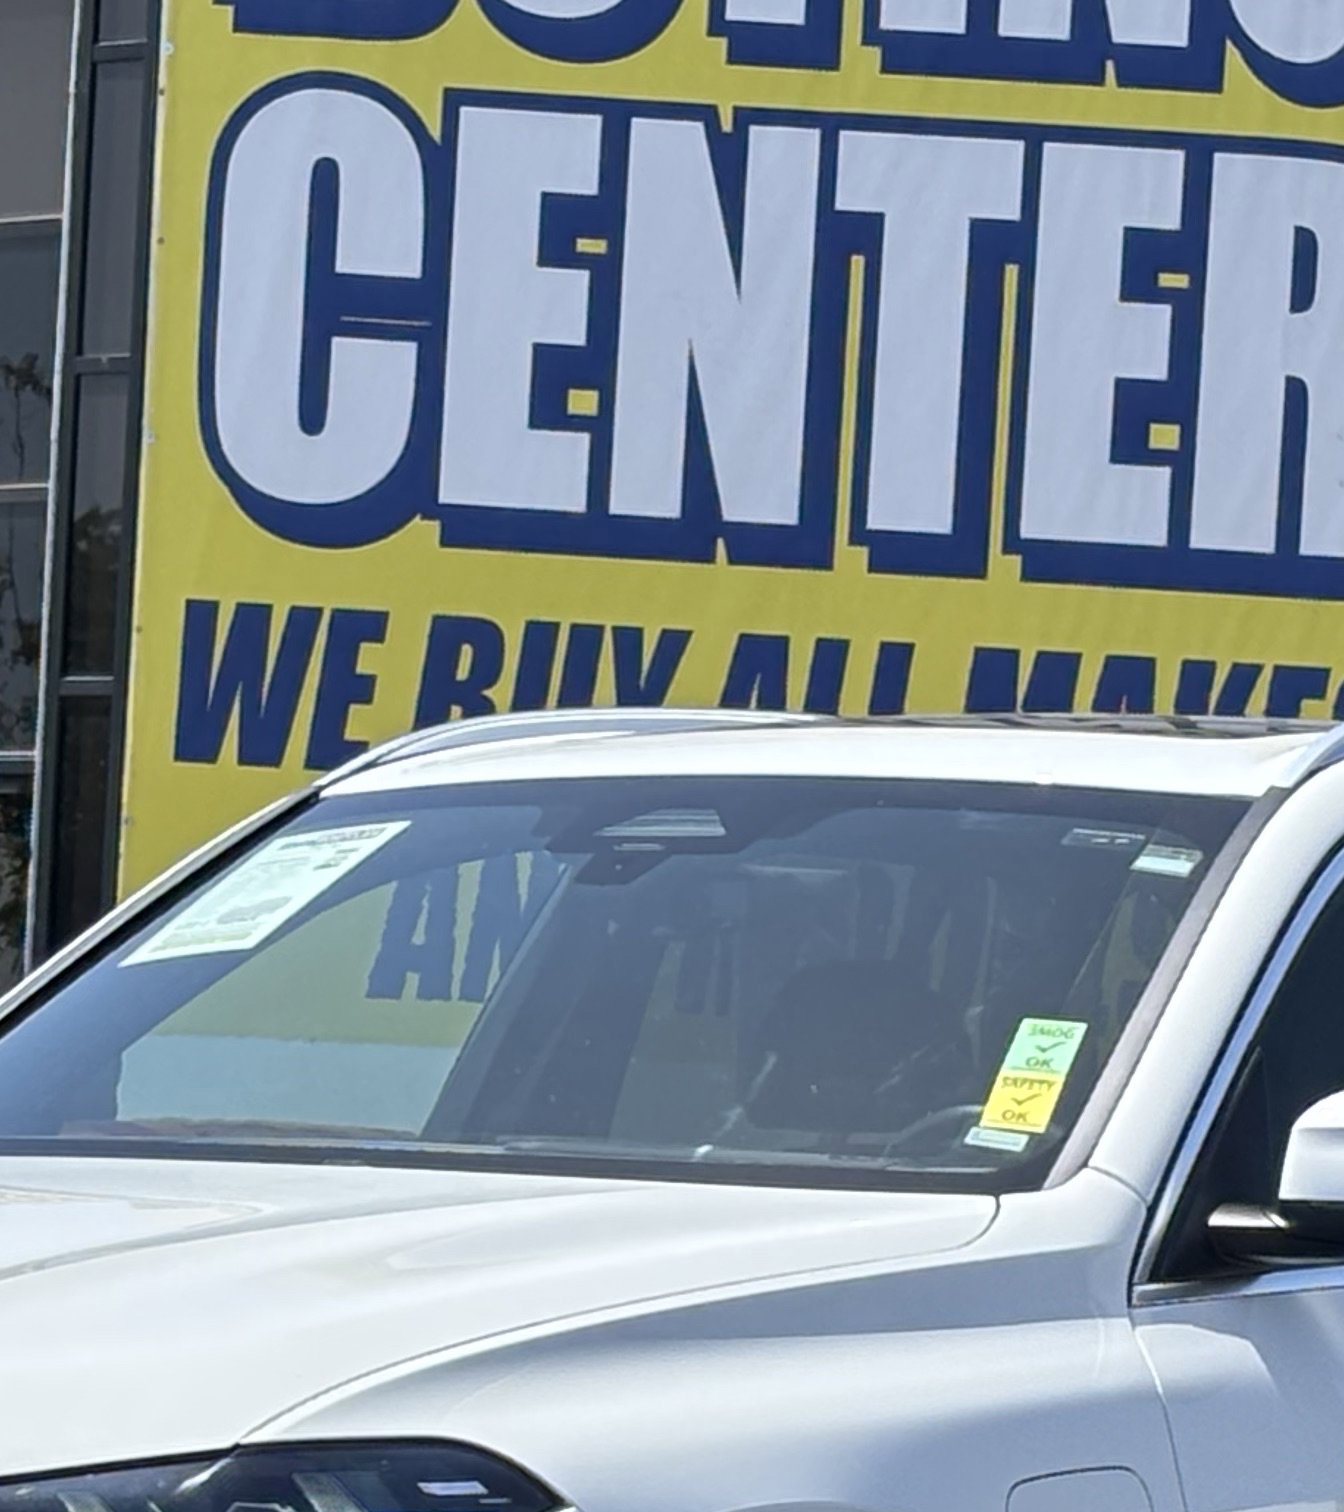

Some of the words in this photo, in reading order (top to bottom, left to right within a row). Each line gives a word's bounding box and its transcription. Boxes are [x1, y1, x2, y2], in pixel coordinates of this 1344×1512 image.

[172, 597, 390, 770] WE
[1025, 1056, 1054, 1069] OK
[1001, 1109, 1030, 1123] OK
